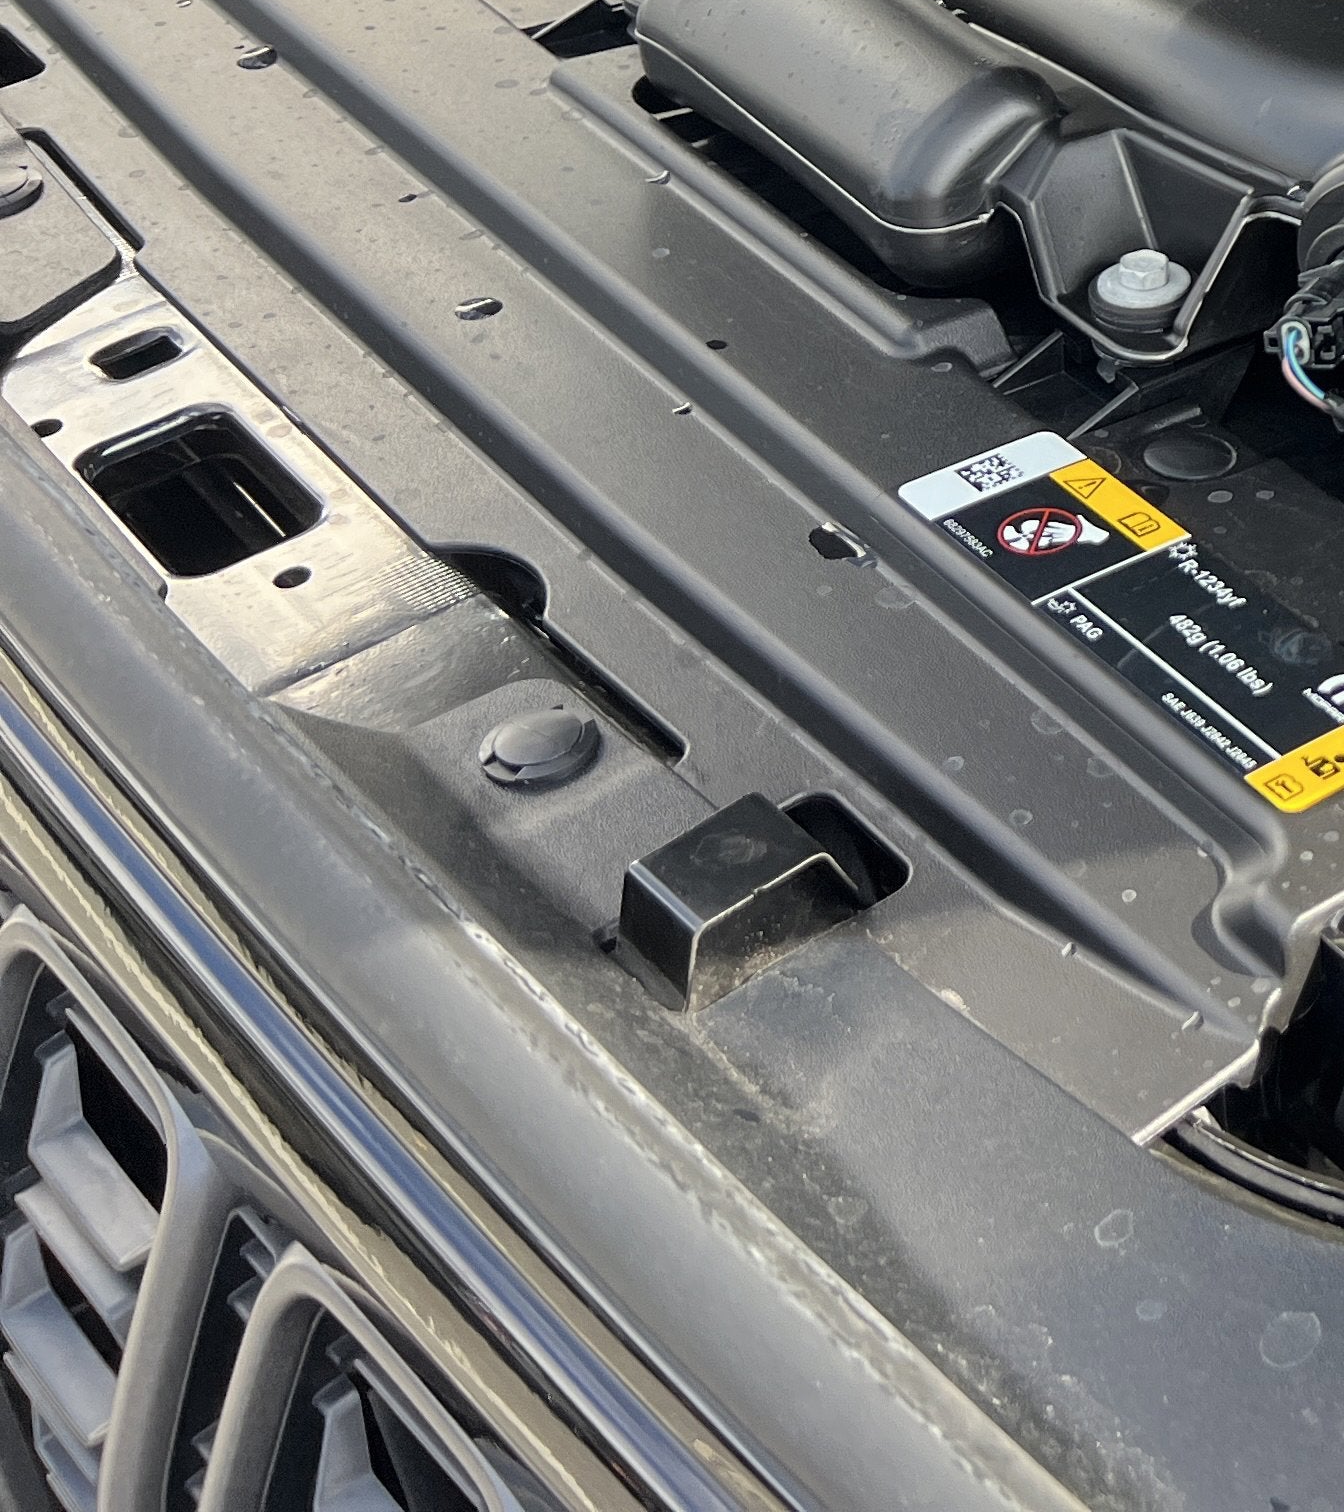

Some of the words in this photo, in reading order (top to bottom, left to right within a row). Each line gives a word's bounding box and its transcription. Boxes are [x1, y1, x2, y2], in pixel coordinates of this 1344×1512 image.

[1177, 558, 1247, 609] R-1234yf
[1069, 614, 1103, 640] PAG
[1169, 614, 1207, 648] 482g
[1198, 640, 1245, 673] (1.06
[1236, 666, 1274, 698] lbs)
[1161, 692, 1187, 713] SAE
